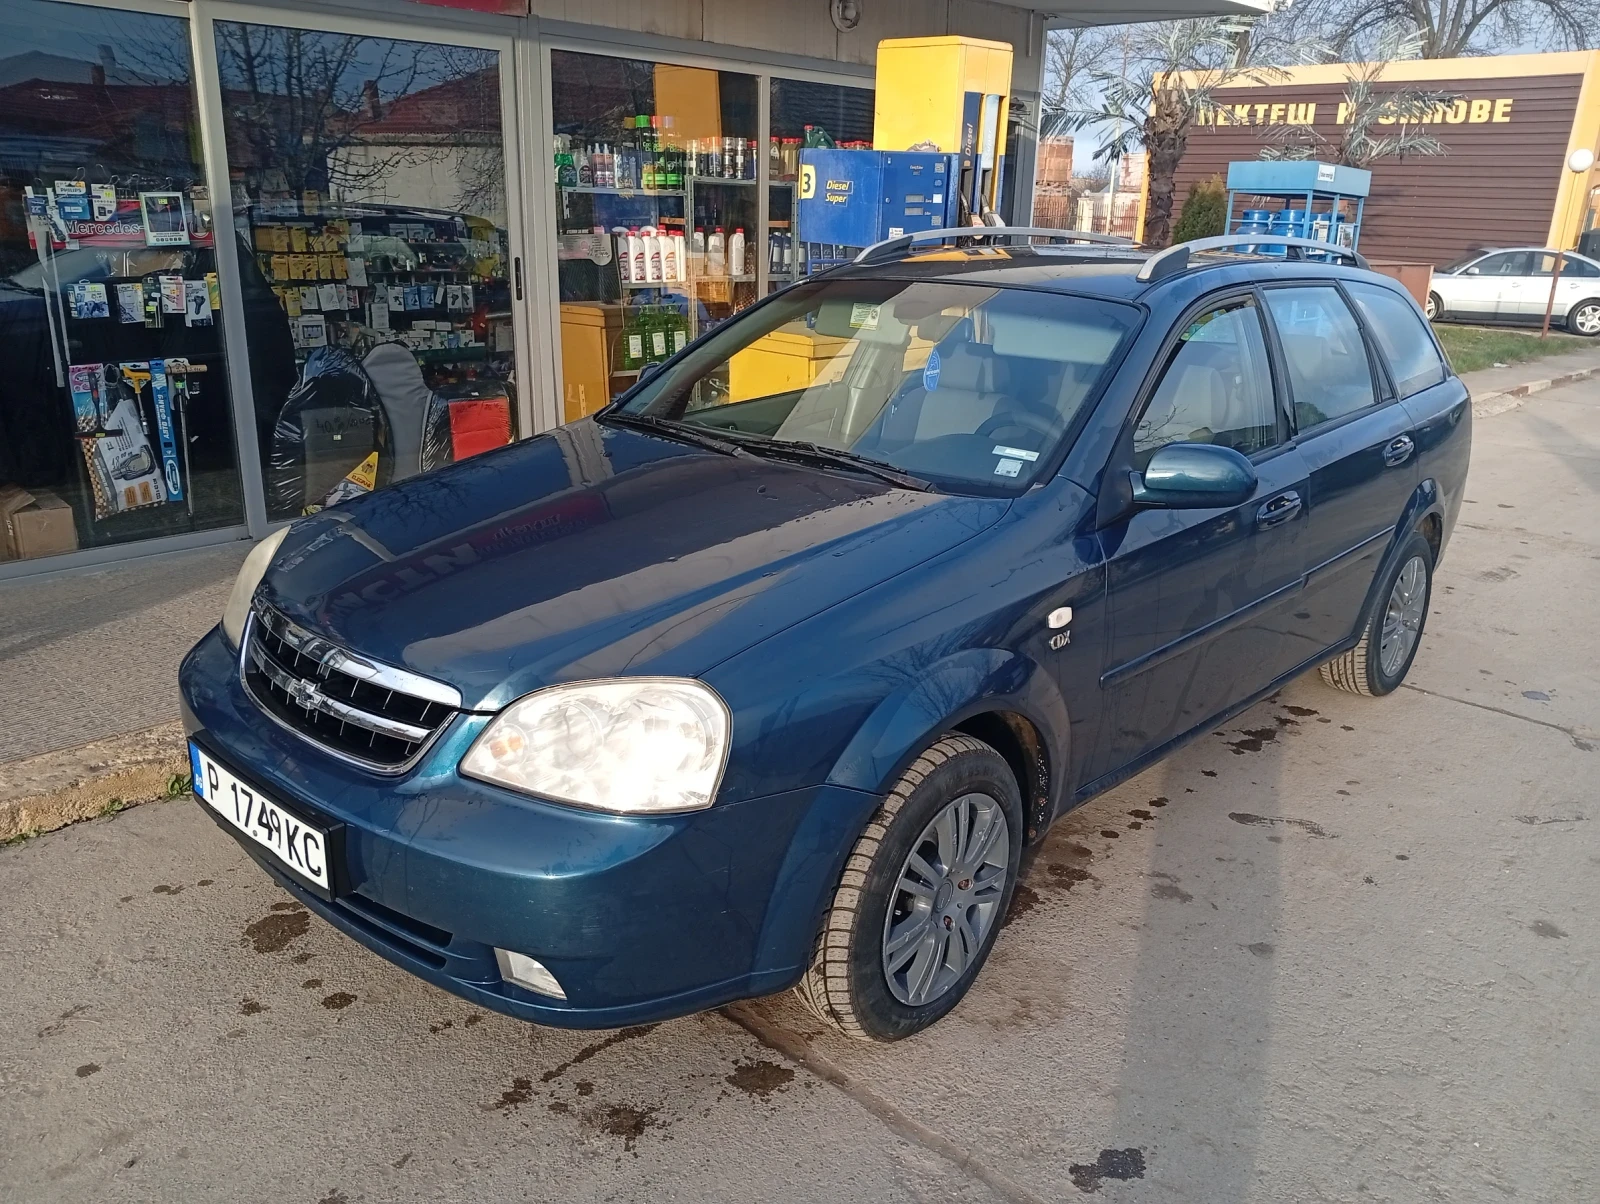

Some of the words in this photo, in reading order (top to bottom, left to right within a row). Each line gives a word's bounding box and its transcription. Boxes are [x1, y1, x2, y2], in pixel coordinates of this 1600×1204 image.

[964, 123, 973, 157] Diesel
[802, 172, 812, 193] 3
[826, 179, 850, 191] Diesel
[825, 192, 848, 206] Super
[1048, 629, 1071, 651] CDX
[196, 774, 203, 789] BG
[207, 761, 219, 801] P
